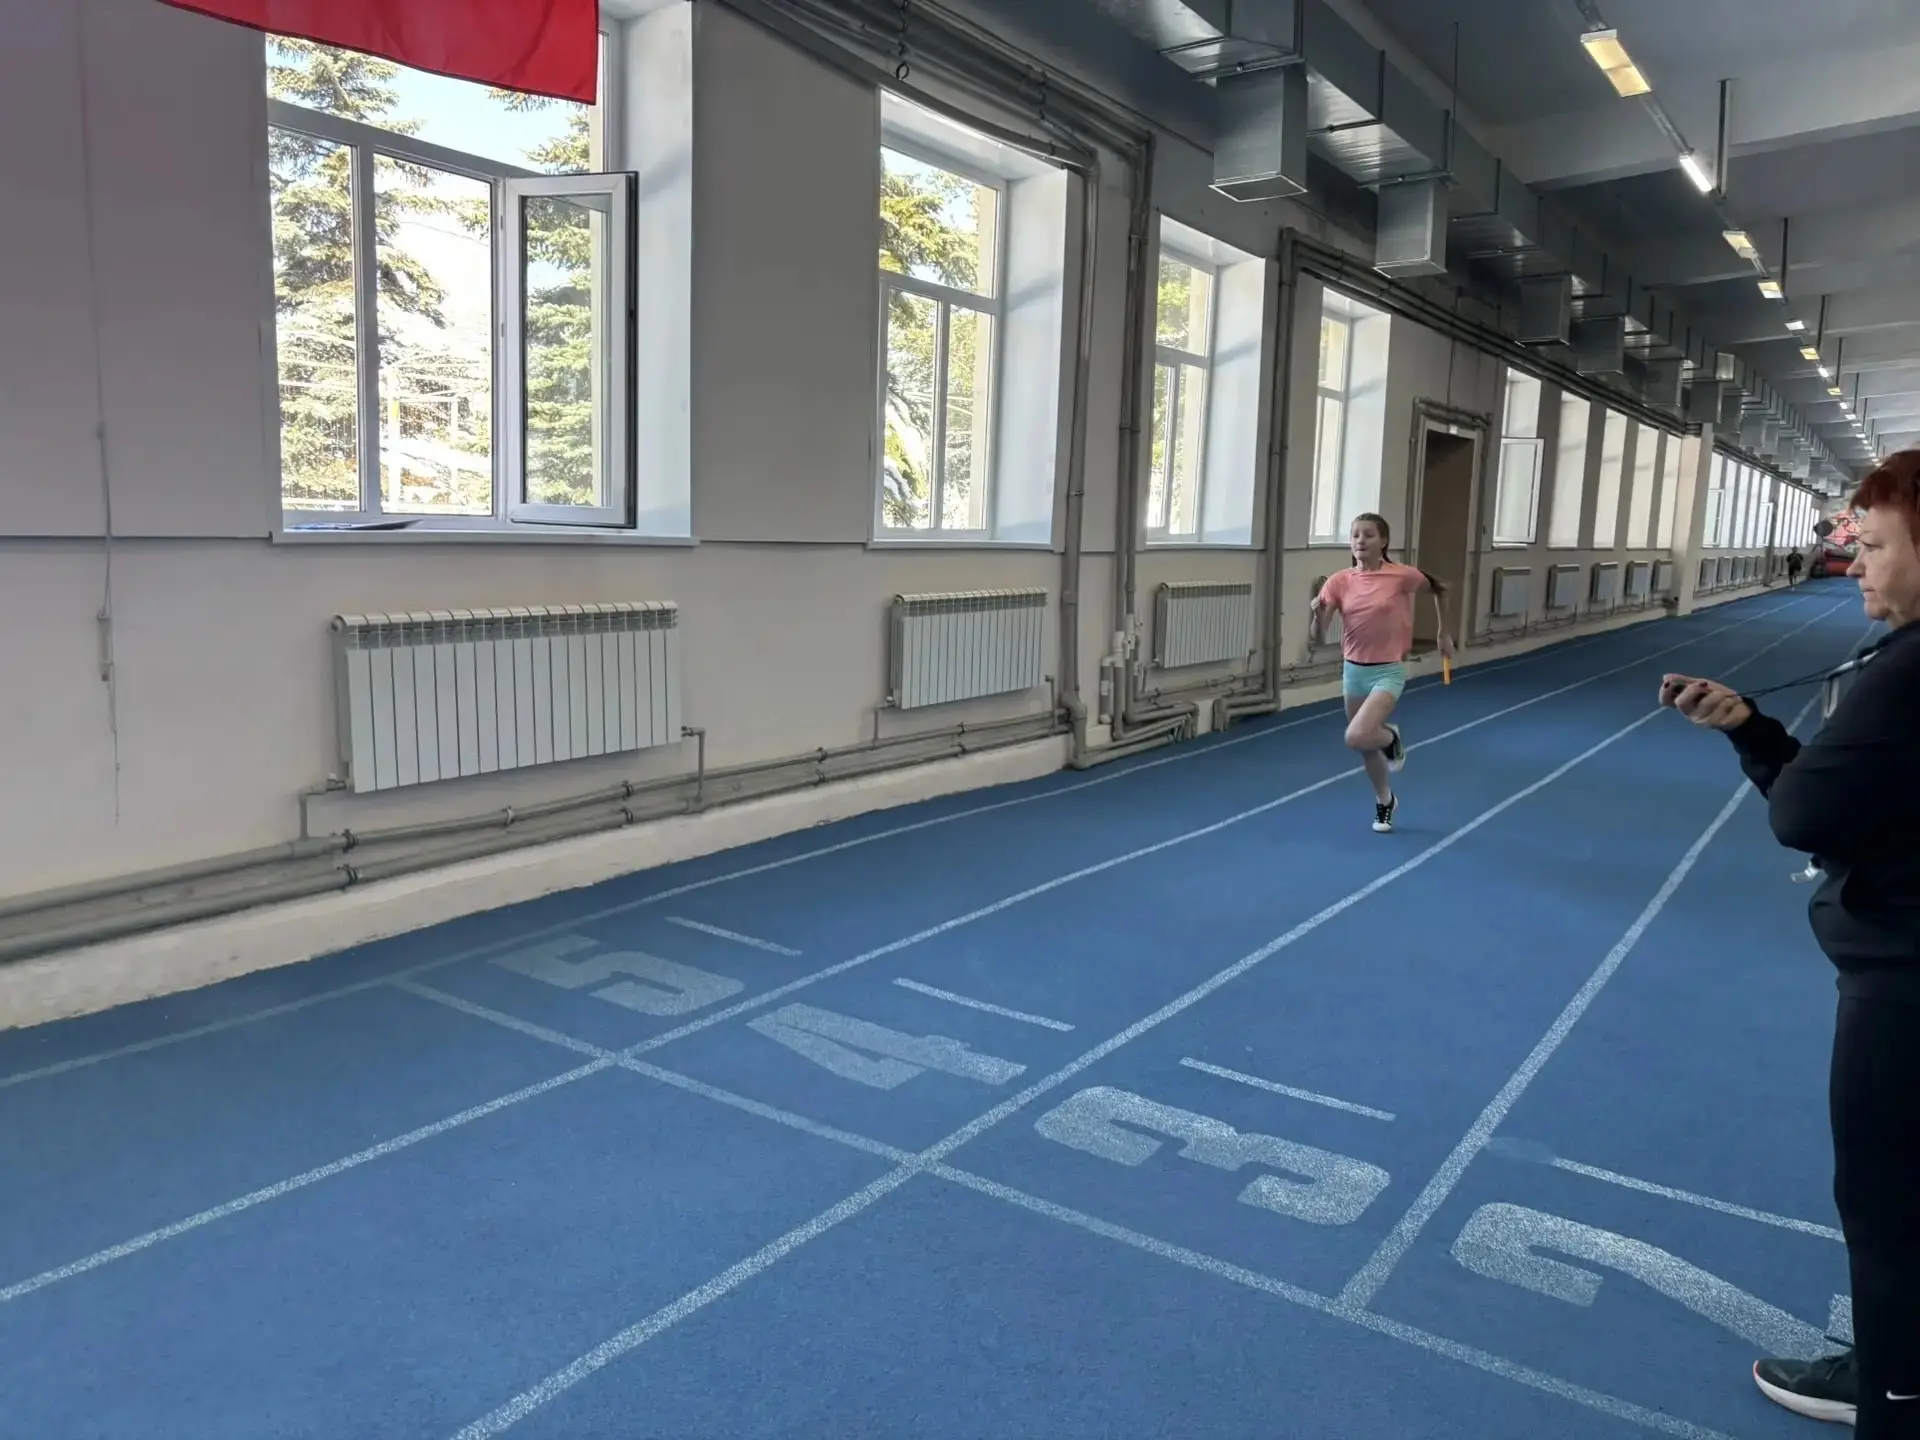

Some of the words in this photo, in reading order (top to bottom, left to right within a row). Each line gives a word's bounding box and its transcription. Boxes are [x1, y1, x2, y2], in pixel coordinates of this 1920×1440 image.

[488, 933, 745, 1017] 5
[746, 1003, 1027, 1090] 4
[1034, 1086, 1391, 1226] 3
